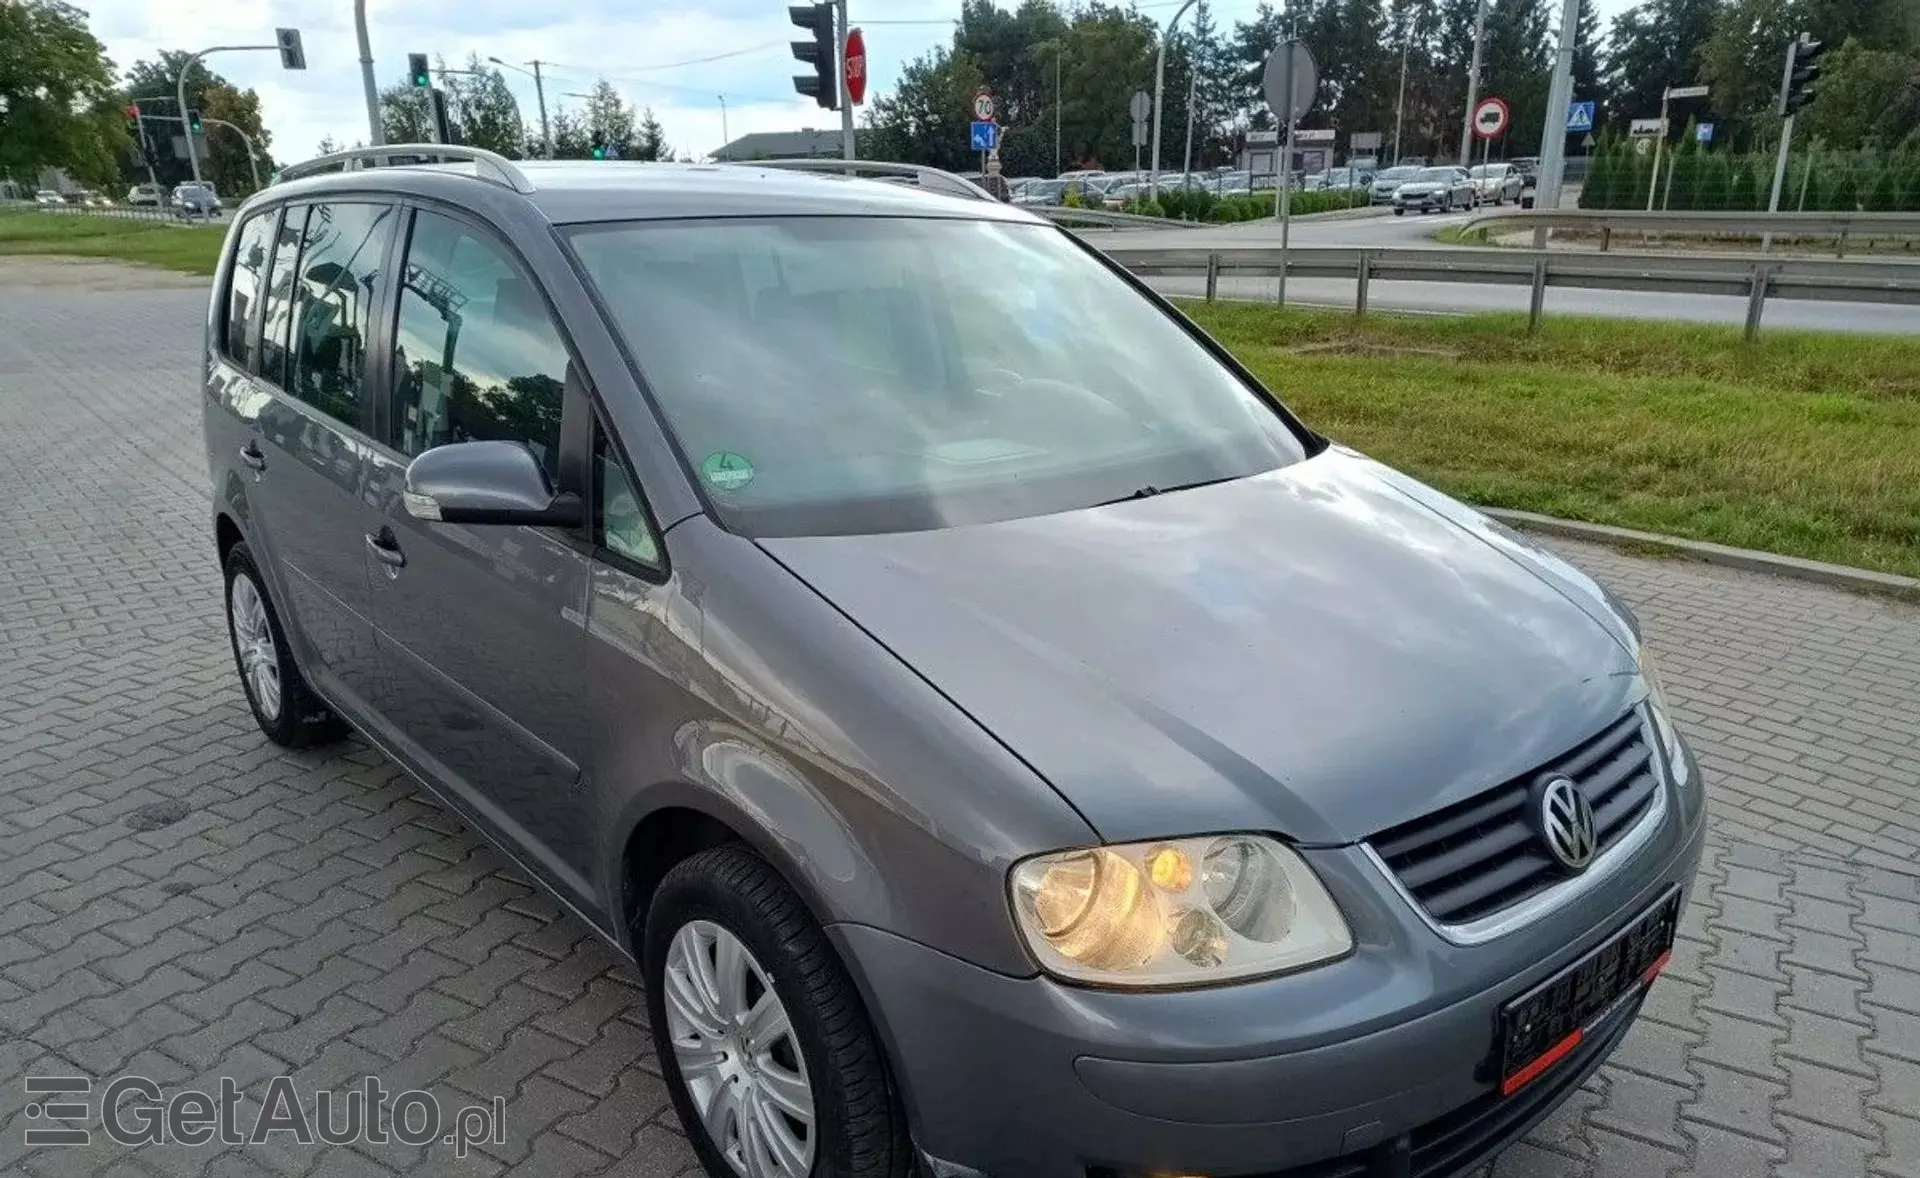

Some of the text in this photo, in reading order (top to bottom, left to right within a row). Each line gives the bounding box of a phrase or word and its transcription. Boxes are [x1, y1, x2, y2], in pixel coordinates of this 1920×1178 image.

[847, 54, 863, 79] STOP
[978, 99, 992, 115] 70
[719, 451, 734, 470] 4
